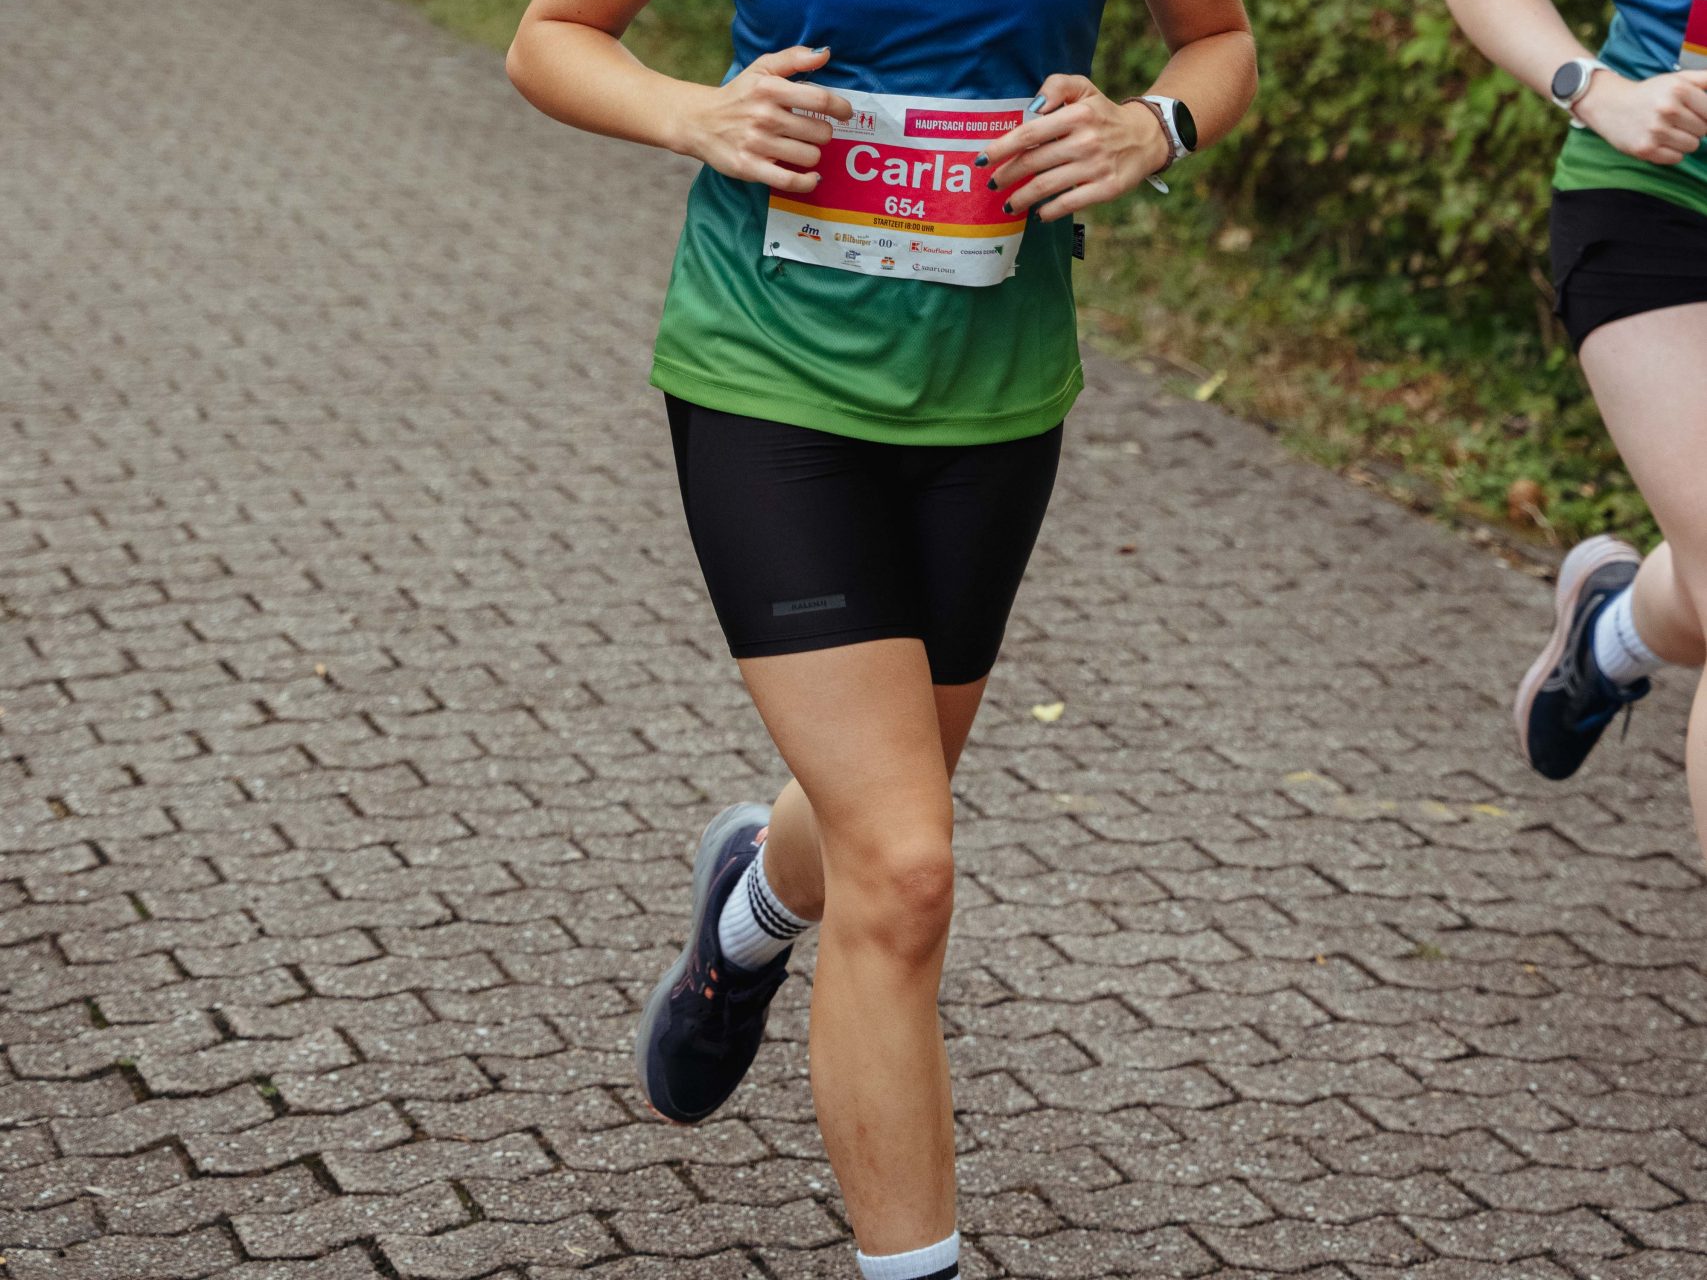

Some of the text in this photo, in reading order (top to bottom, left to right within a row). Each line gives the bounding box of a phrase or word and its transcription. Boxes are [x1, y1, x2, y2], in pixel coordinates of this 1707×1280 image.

[915, 118, 964, 132] HAUPTSACH
[965, 121, 988, 132] GUDD
[845, 144, 972, 193] Carla
[884, 195, 926, 219] 654
[801, 223, 820, 236] dm
[873, 217, 903, 229] STARTZEIT
[921, 224, 935, 233] UHR
[923, 246, 953, 256] Kaufland
